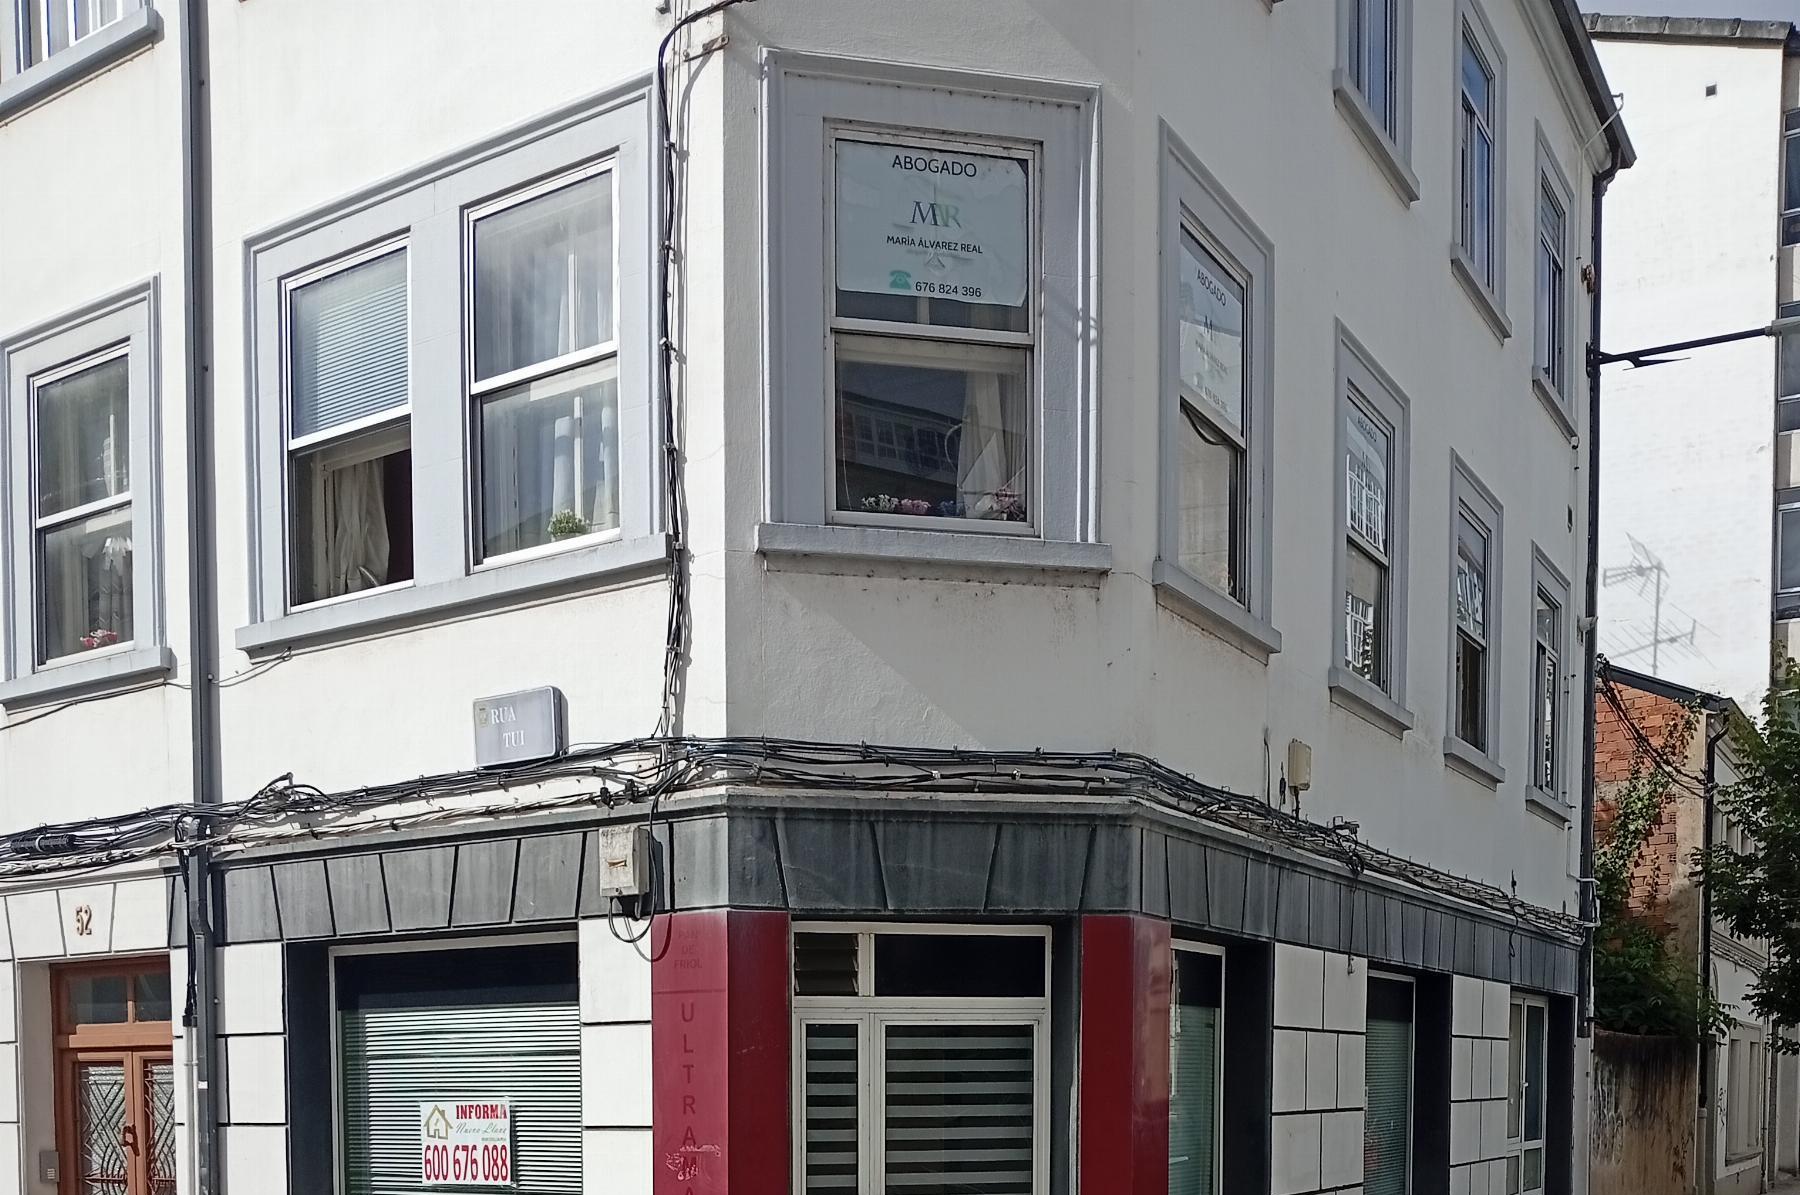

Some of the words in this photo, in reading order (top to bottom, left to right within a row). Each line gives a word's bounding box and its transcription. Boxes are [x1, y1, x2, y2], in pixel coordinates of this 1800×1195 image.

[892, 154, 977, 178] ABOGADO
[886, 234, 916, 247] MARÍA
[917, 237, 958, 251] ÁLVAREZ
[960, 243, 983, 254] REAL
[915, 281, 936, 293] 676
[938, 283, 958, 296] 824
[961, 286, 982, 298] 396
[1197, 269, 1226, 307] ABOGADO
[491, 706, 516, 725] RUA
[503, 730, 525, 748] TUI
[75, 904, 93, 936] 52
[424, 1144, 449, 1181] 600
[453, 1144, 479, 1181] 676
[482, 1144, 509, 1182] 088
